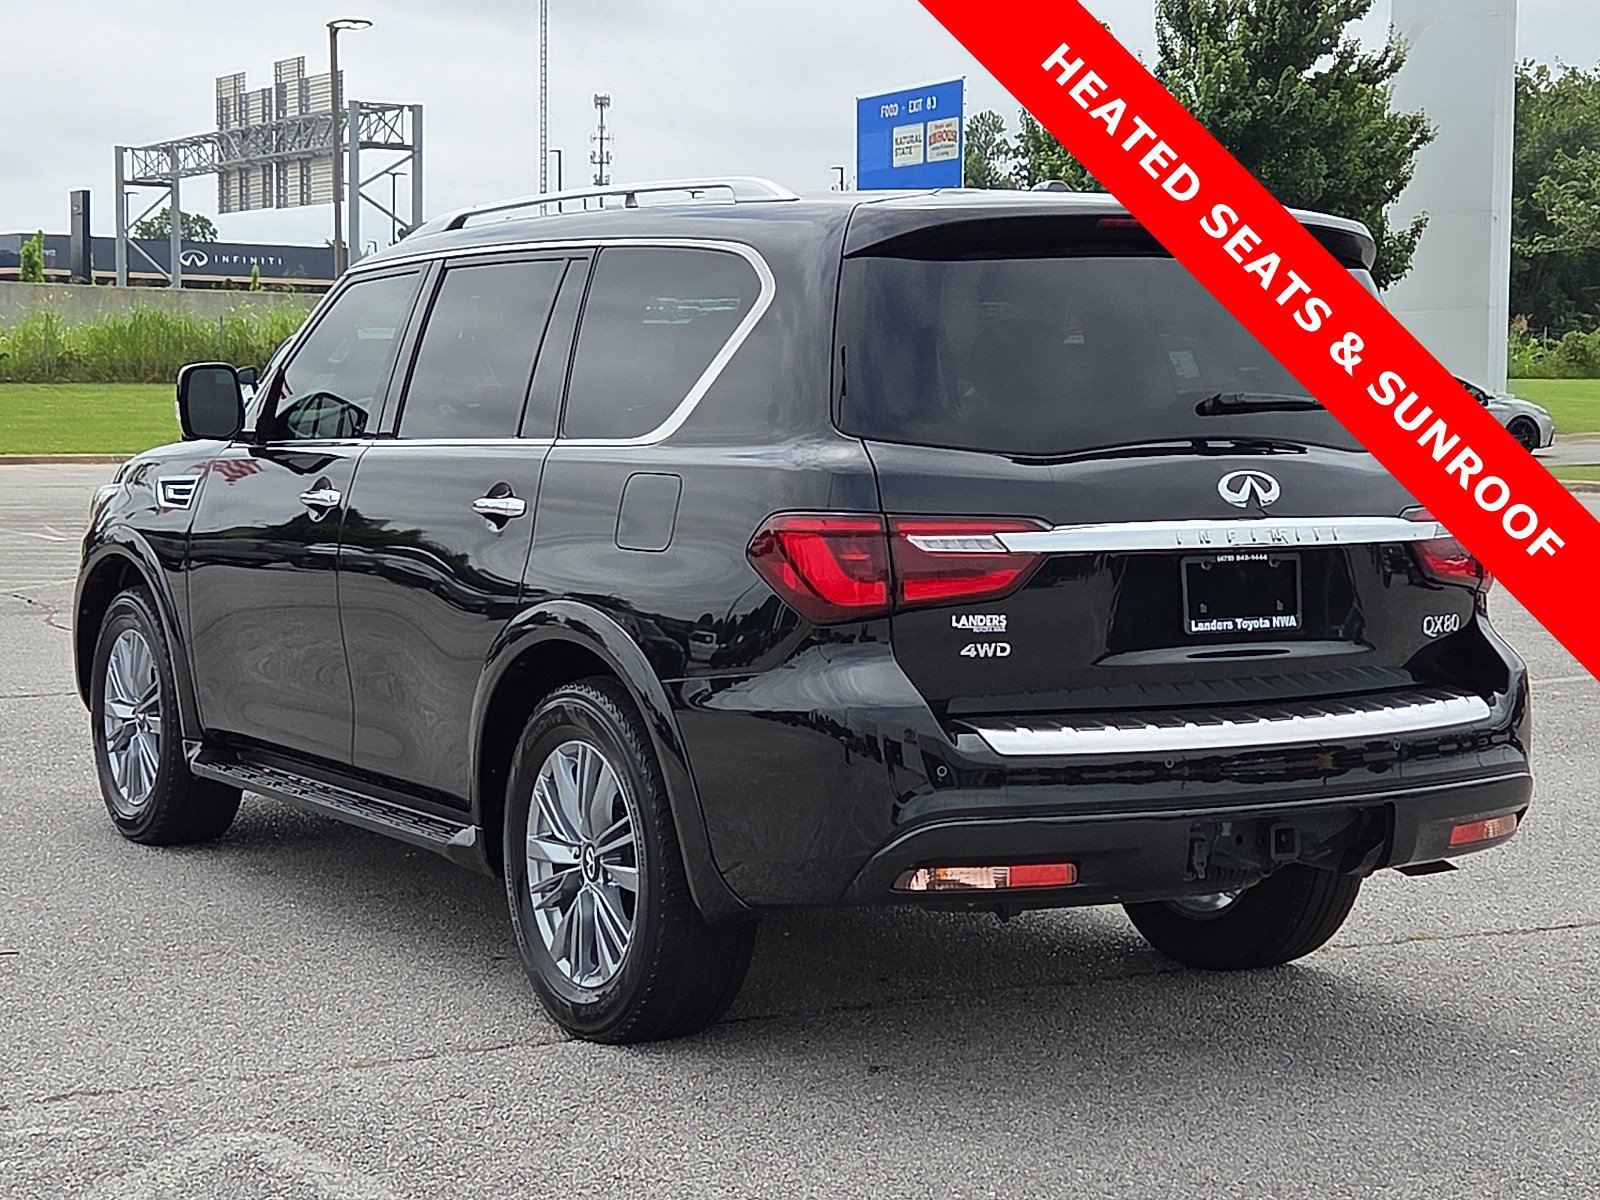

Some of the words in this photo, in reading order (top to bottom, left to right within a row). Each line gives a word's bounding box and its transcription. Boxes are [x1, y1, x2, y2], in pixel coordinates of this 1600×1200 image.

[880, 102, 899, 118] FOOD
[908, 98, 923, 113] EXIT
[894, 133, 922, 146] NATURAL
[894, 146, 913, 157] STATE
[214, 254, 284, 266] INFINITI
[1175, 526, 1340, 546] INFINITI
[951, 614, 1008, 628] LANDERS
[1191, 619, 1234, 632] Landers
[1235, 618, 1270, 632] Toyota
[1272, 615, 1297, 628] NWA
[1422, 613, 1460, 638] QX80
[960, 642, 1011, 658] 4WD
